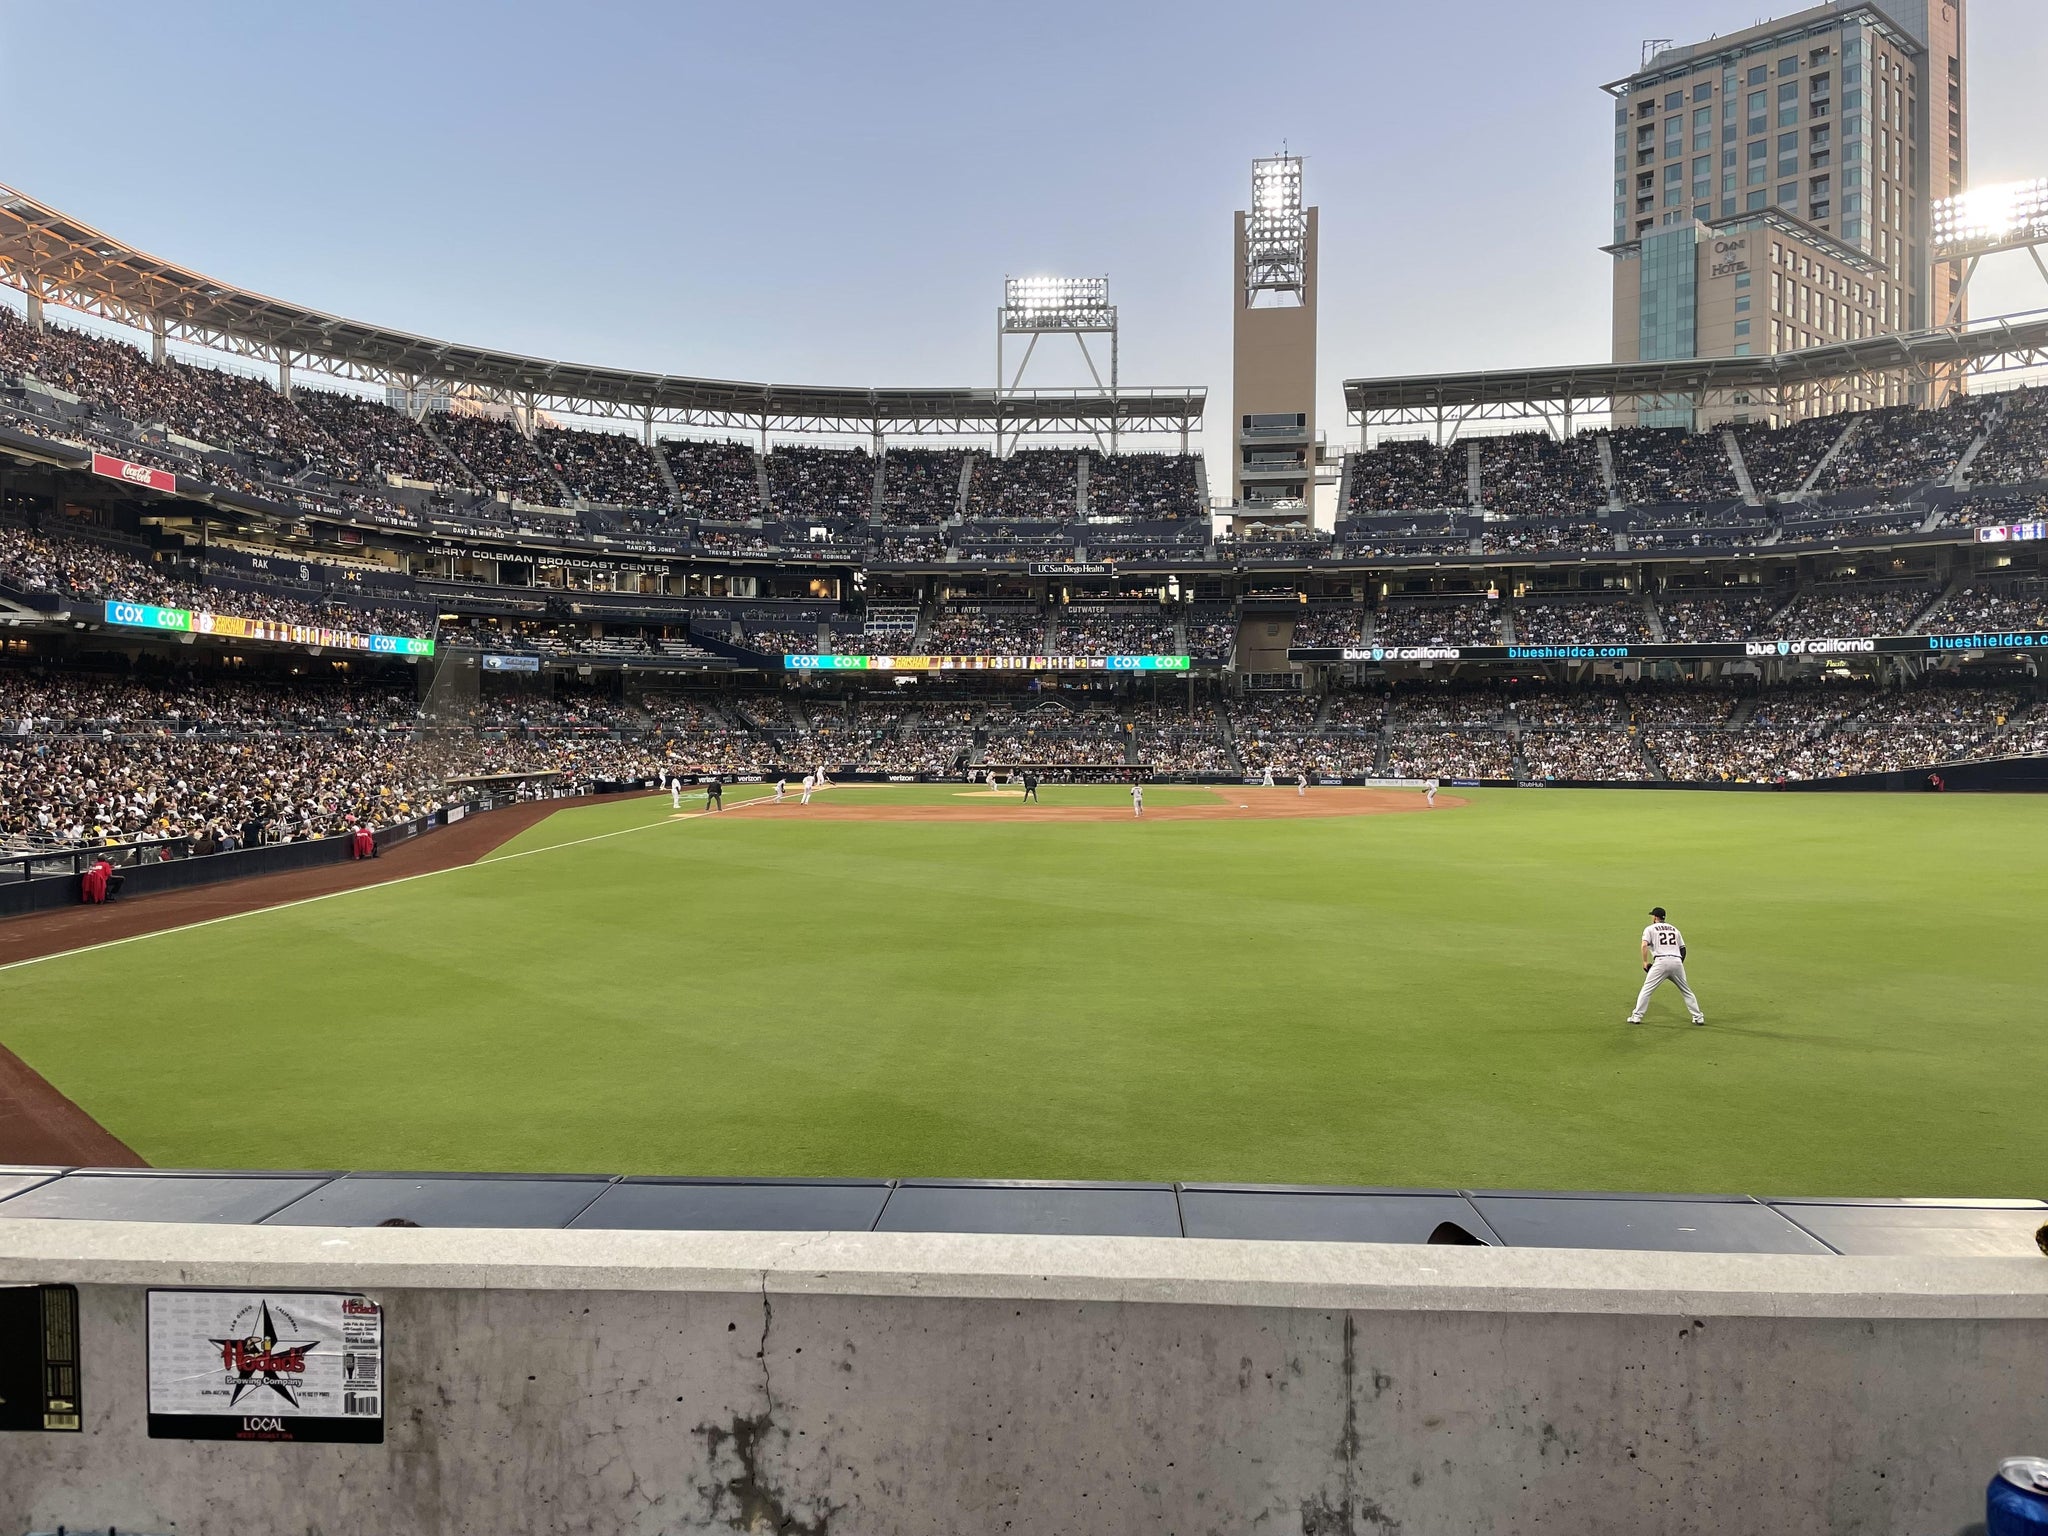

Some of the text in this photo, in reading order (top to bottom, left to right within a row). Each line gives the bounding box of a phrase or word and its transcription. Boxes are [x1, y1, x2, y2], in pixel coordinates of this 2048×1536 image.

[1714, 239, 1746, 254] OMNI
[1712, 260, 1748, 276] HOTEL
[322, 505, 342, 516] GARVEY
[374, 515, 418, 529] TONY 19 GWYNN
[452, 527, 505, 539] DAVE 31 WINFIELD
[252, 558, 269, 569] RAK
[427, 546, 670, 572] JERRY COLEMAN BROADCAST CENTER
[1038, 564, 1105, 574] UC San Diego Health
[115, 605, 185, 627] COX COX
[216, 616, 245, 635] GRISHAM
[374, 638, 396, 651] COX
[407, 641, 428, 653] COX
[1746, 638, 1874, 655] blue of california
[1344, 646, 1459, 659] blue of california
[1508, 646, 1628, 659] blueshieldca.com
[792, 656, 861, 667] COX COX
[895, 657, 930, 668] GRISHAM
[1113, 657, 1182, 667] COX COX
[1659, 932, 1676, 945] 22
[236, 1305, 253, 1319] DIEGO
[275, 1306, 299, 1333] CALIFORNIA
[225, 1375, 303, 1388] Brewing Company
[243, 1417, 286, 1431] LOCAL
